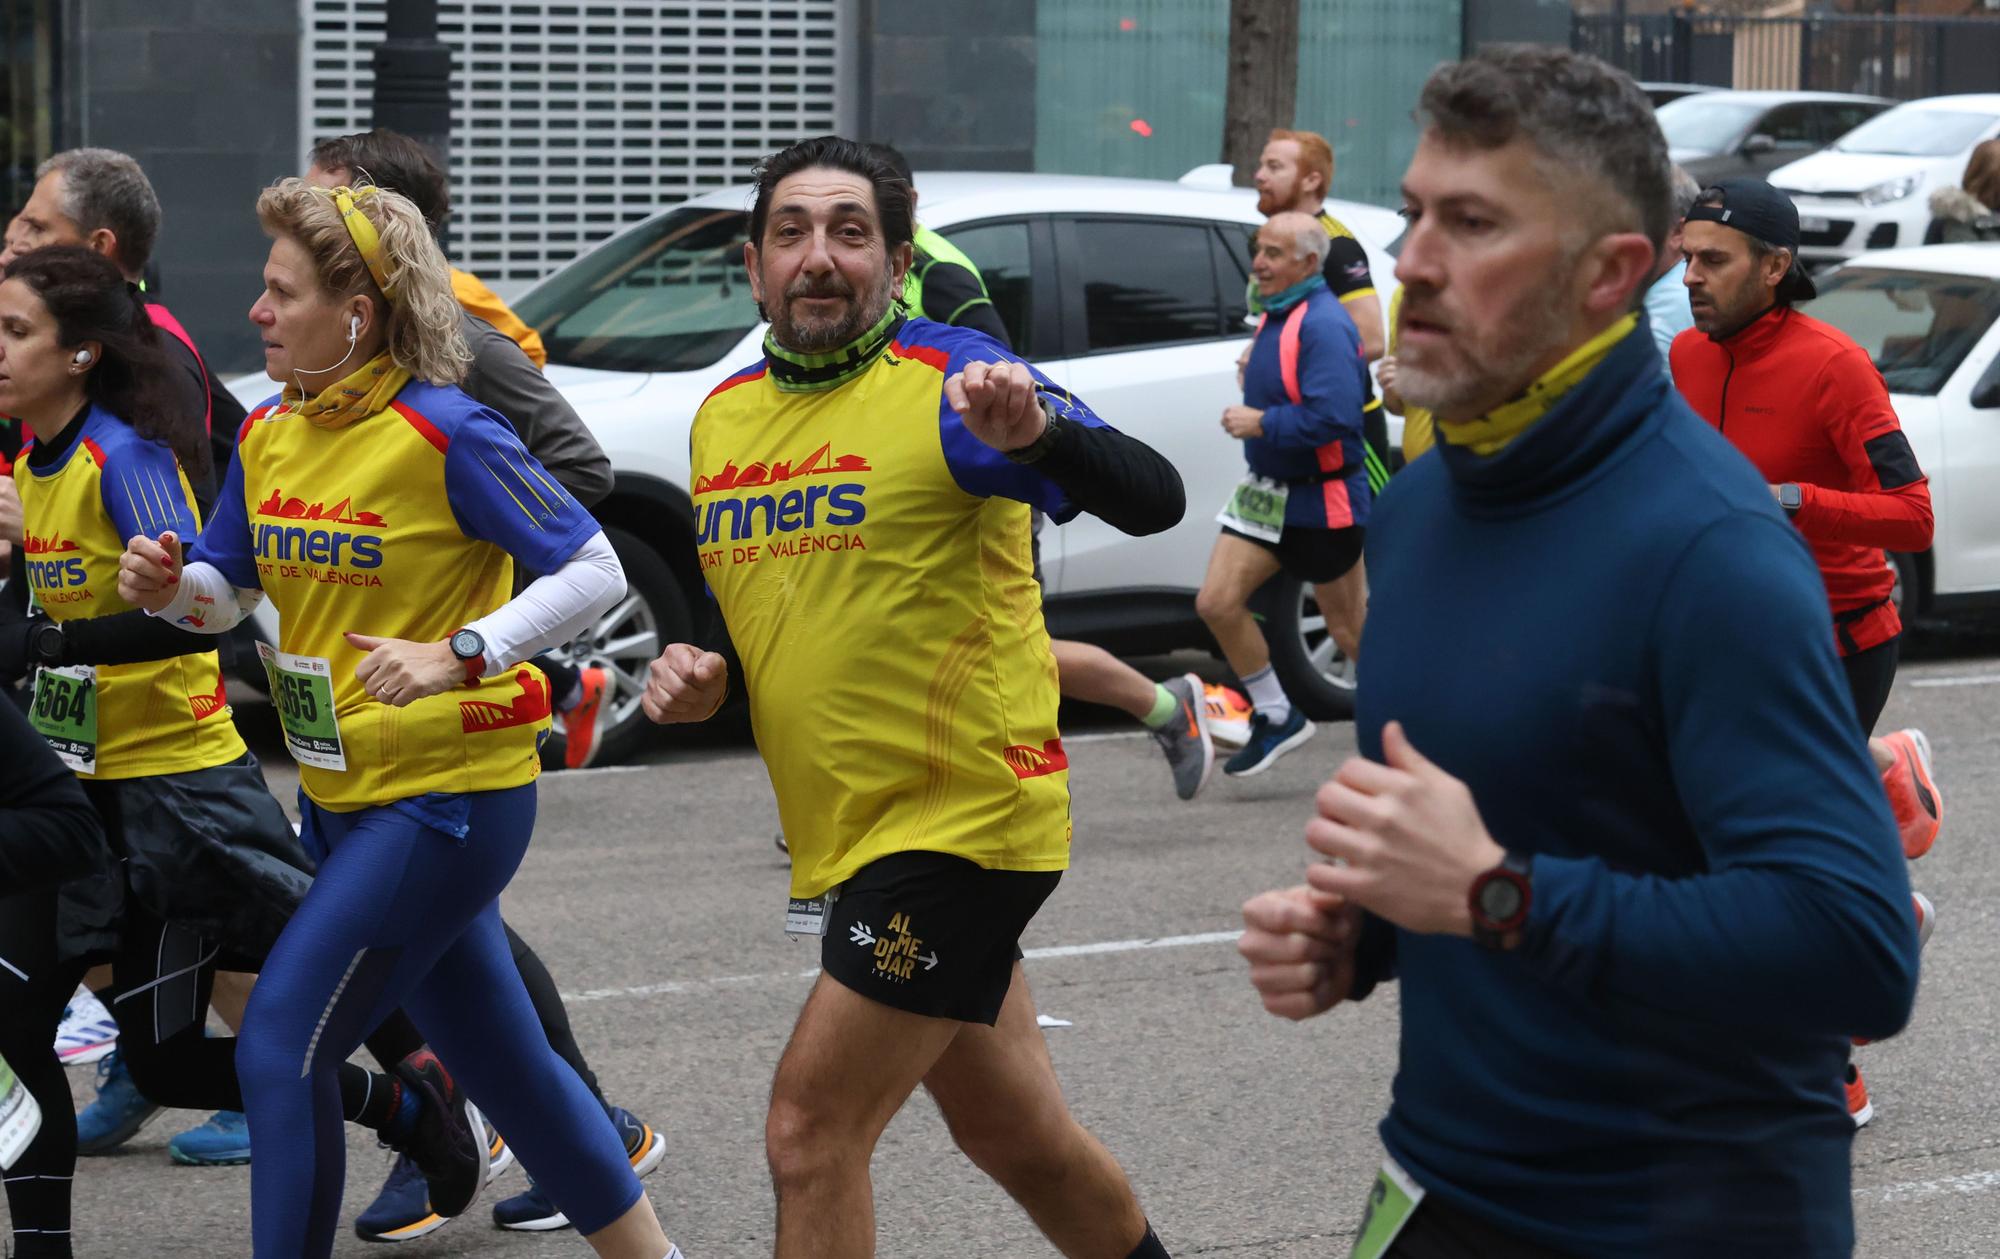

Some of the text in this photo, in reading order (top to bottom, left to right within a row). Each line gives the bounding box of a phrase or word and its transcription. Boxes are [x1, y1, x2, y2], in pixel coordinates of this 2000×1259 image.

[733, 545, 760, 564] DE
[768, 532, 866, 560] VALÈNCIA
[281, 565, 301, 578] DE
[304, 567, 383, 588] VALÈNCIA
[887, 911, 911, 936] AL
[876, 953, 916, 980] JAR
